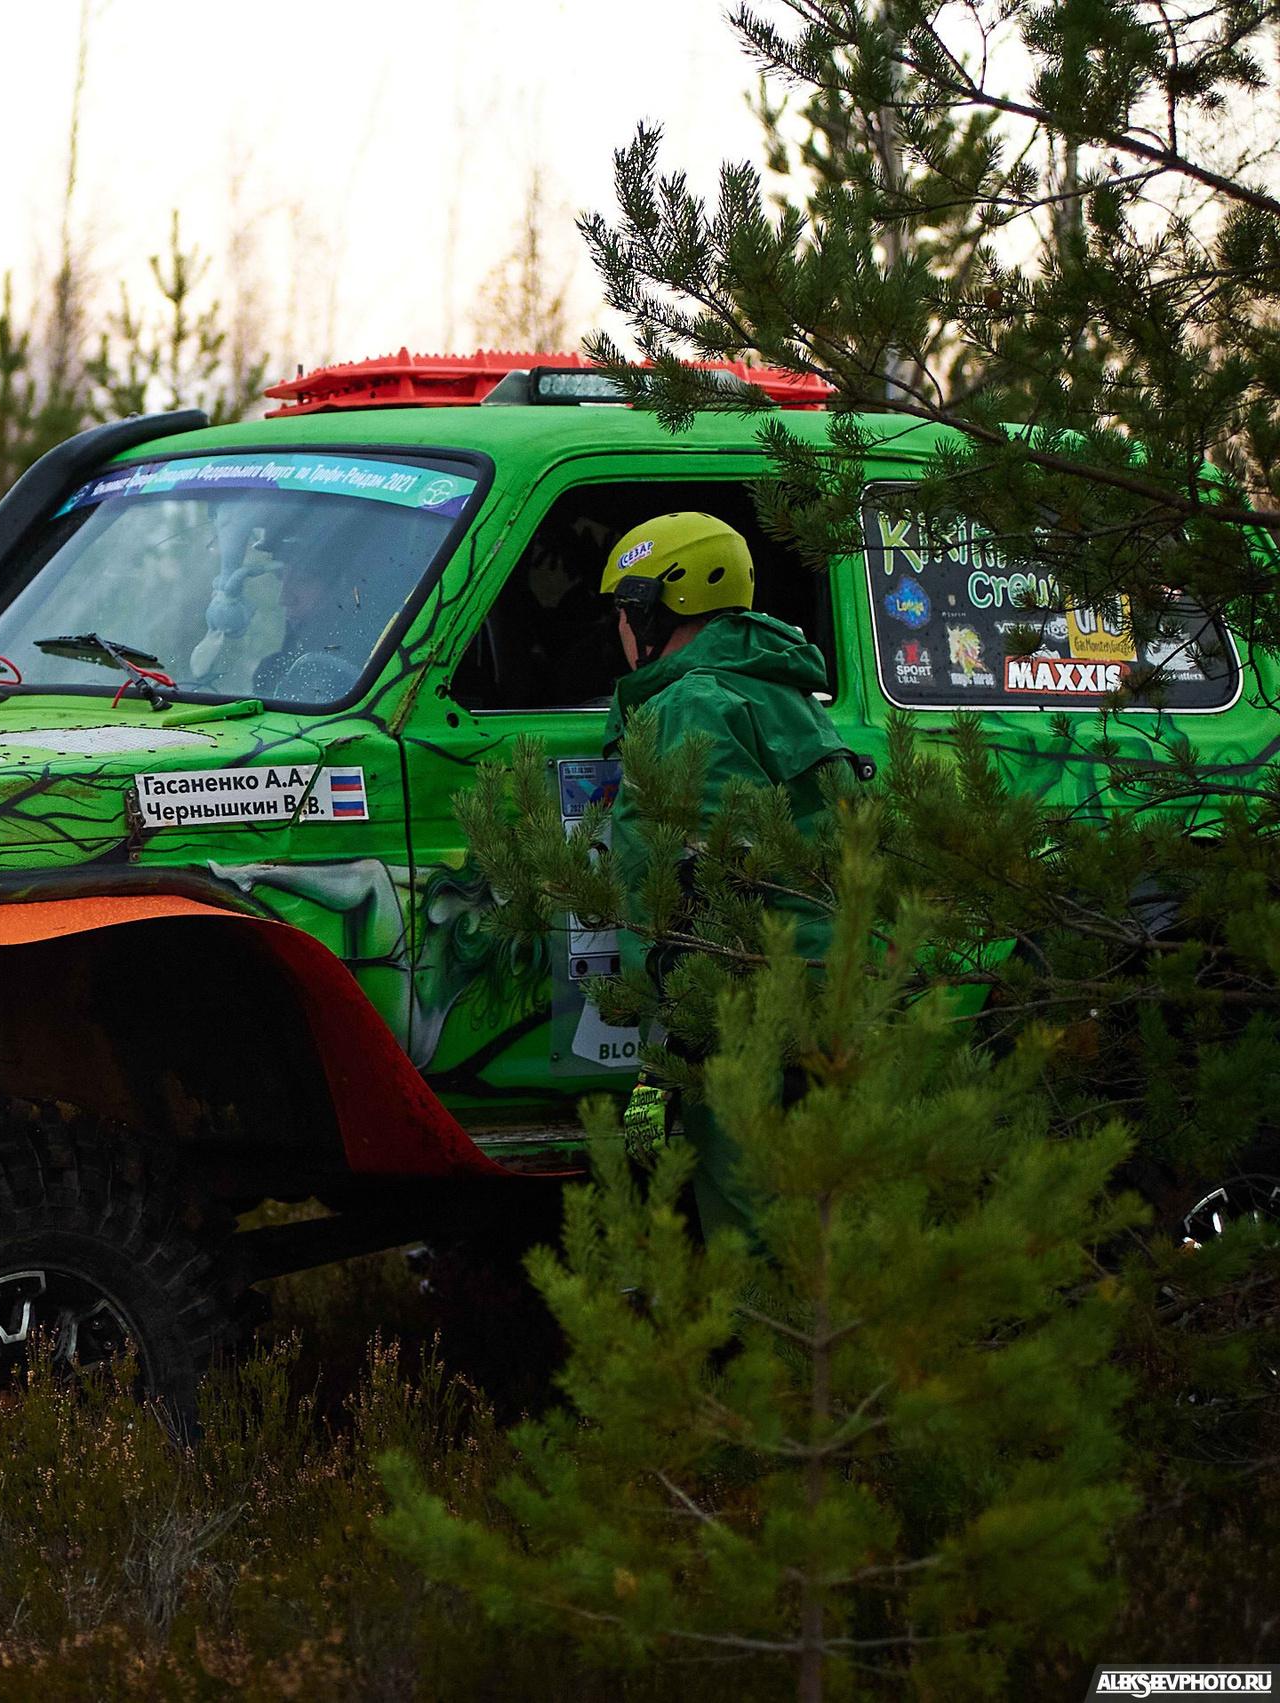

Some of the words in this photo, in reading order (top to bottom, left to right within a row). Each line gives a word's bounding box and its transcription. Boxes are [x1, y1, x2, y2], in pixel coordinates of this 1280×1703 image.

[258, 461, 296, 482] Округа
[294, 466, 312, 480] по
[308, 463, 387, 489] Трофи-Рейдам
[382, 472, 418, 493] 2021
[896, 665, 932, 676] SPORT
[1007, 661, 1122, 692] MAXXIS
[143, 775, 259, 796] Гасаненко
[265, 768, 310, 789] А.А.
[147, 800, 278, 825] Чернышкин
